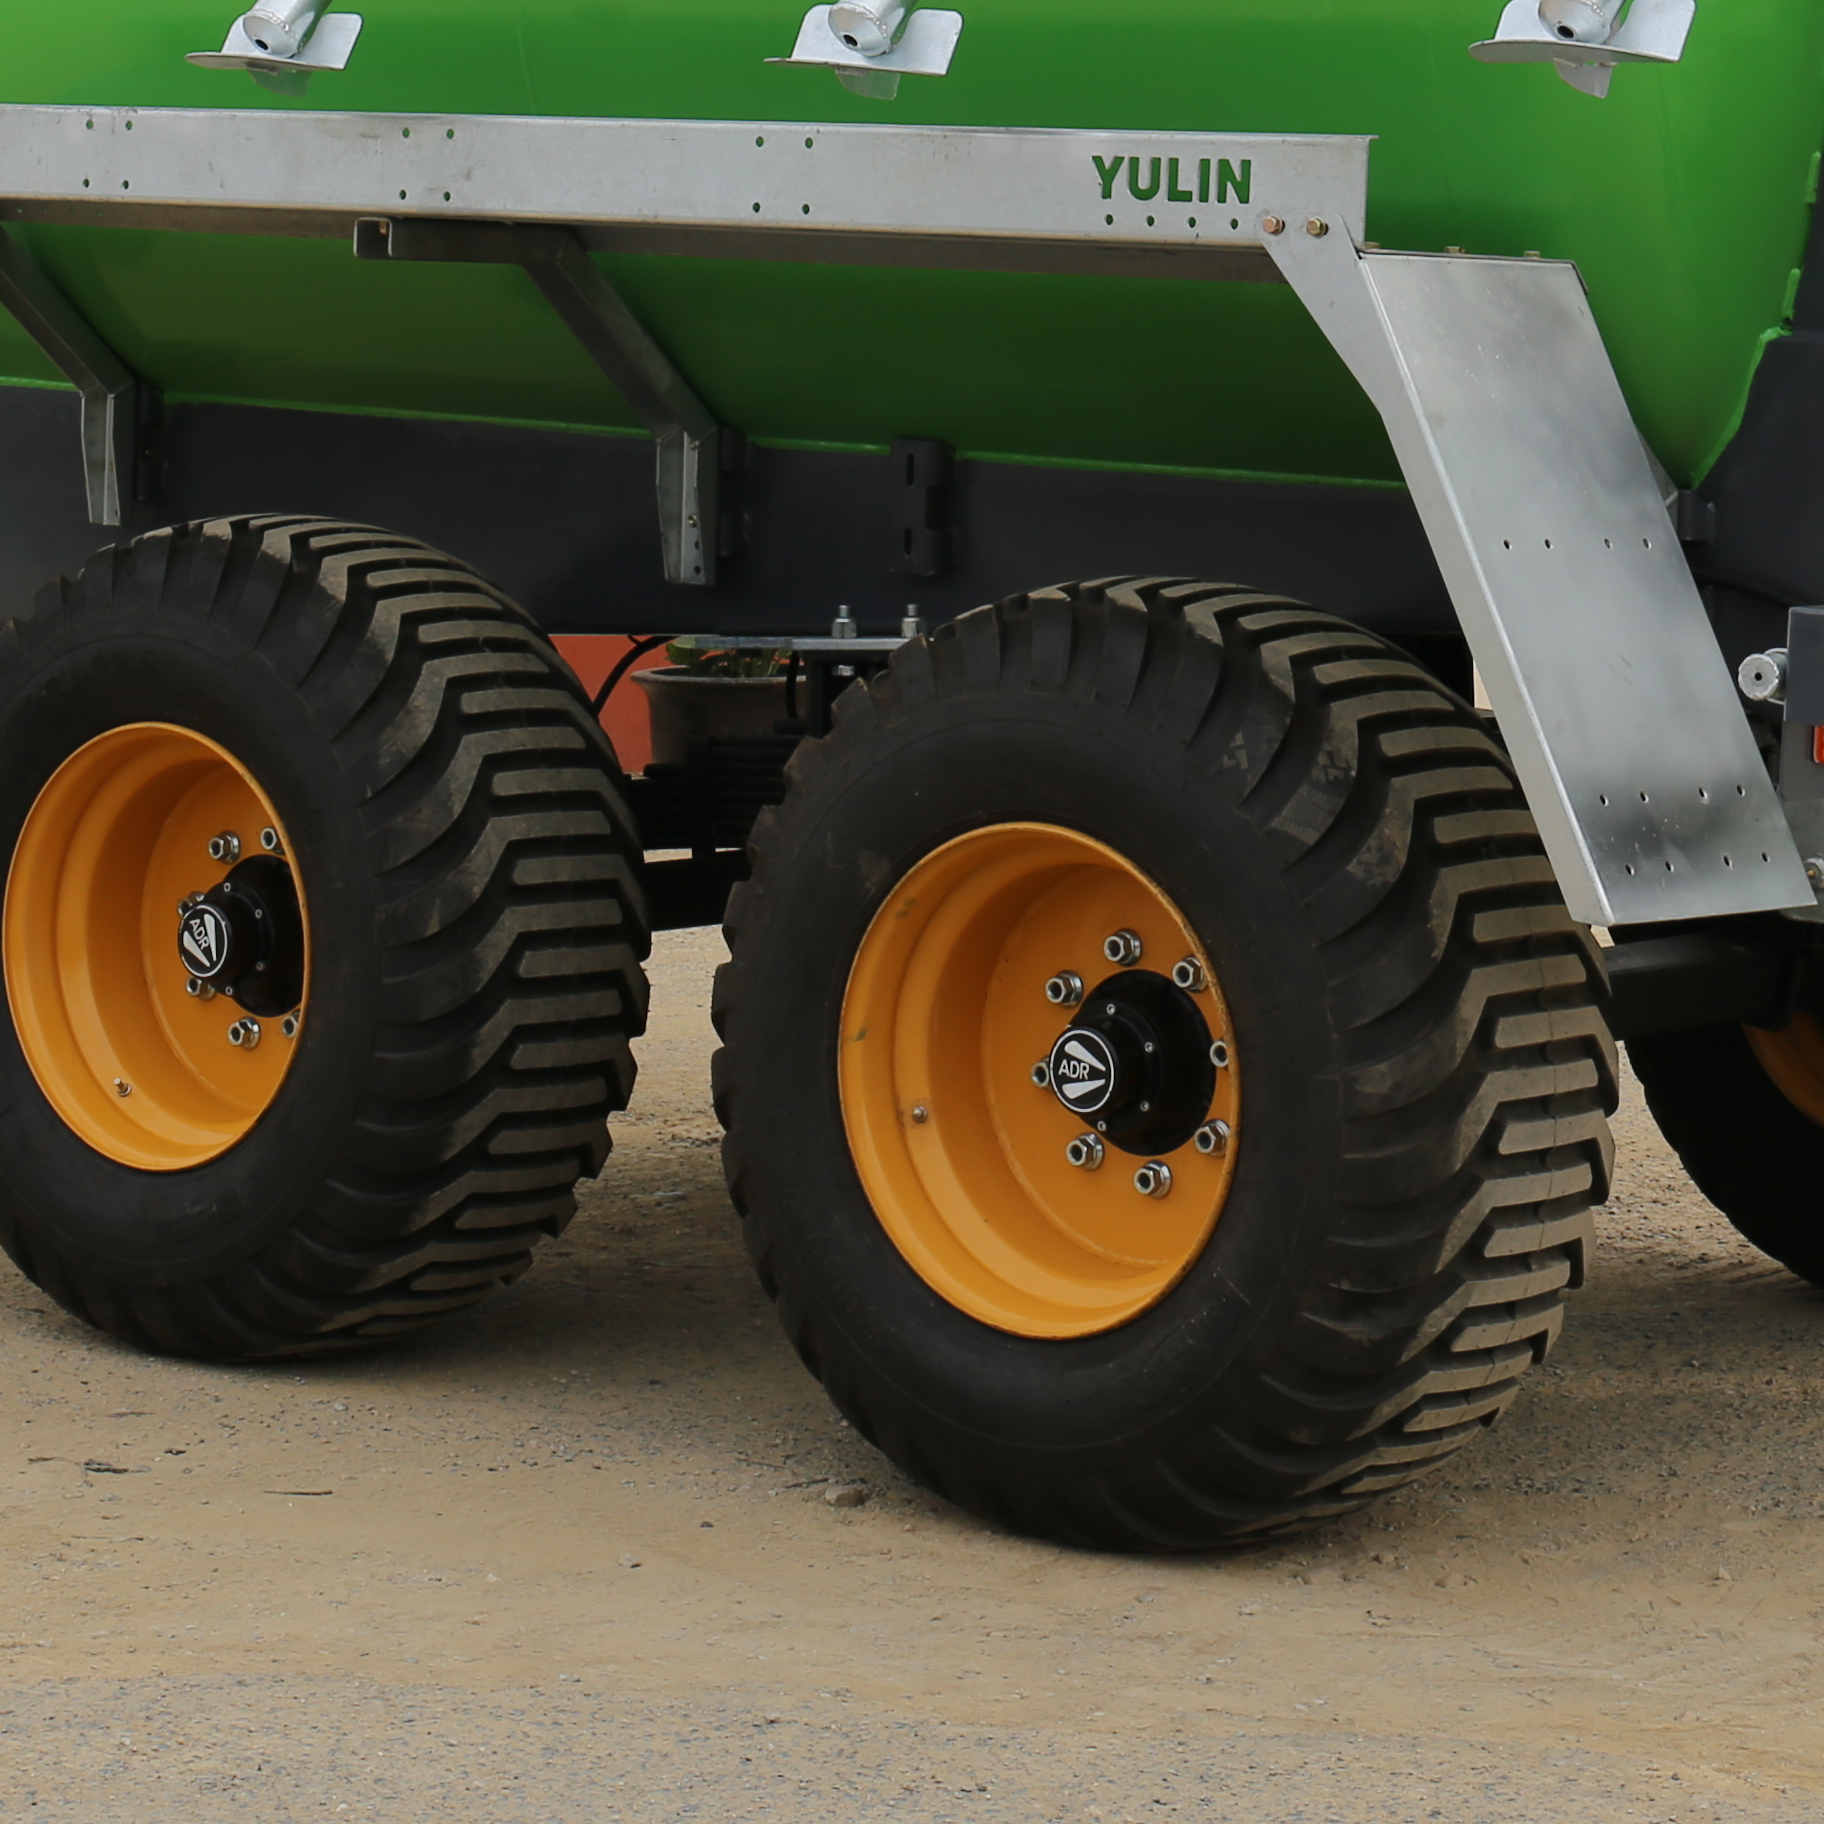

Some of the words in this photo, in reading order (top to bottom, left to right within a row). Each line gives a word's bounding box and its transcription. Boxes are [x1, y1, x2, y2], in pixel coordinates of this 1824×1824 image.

[1091, 154, 1252, 205] YULIN
[188, 918, 210, 950] ADR
[1058, 1058, 1090, 1080] ADR
